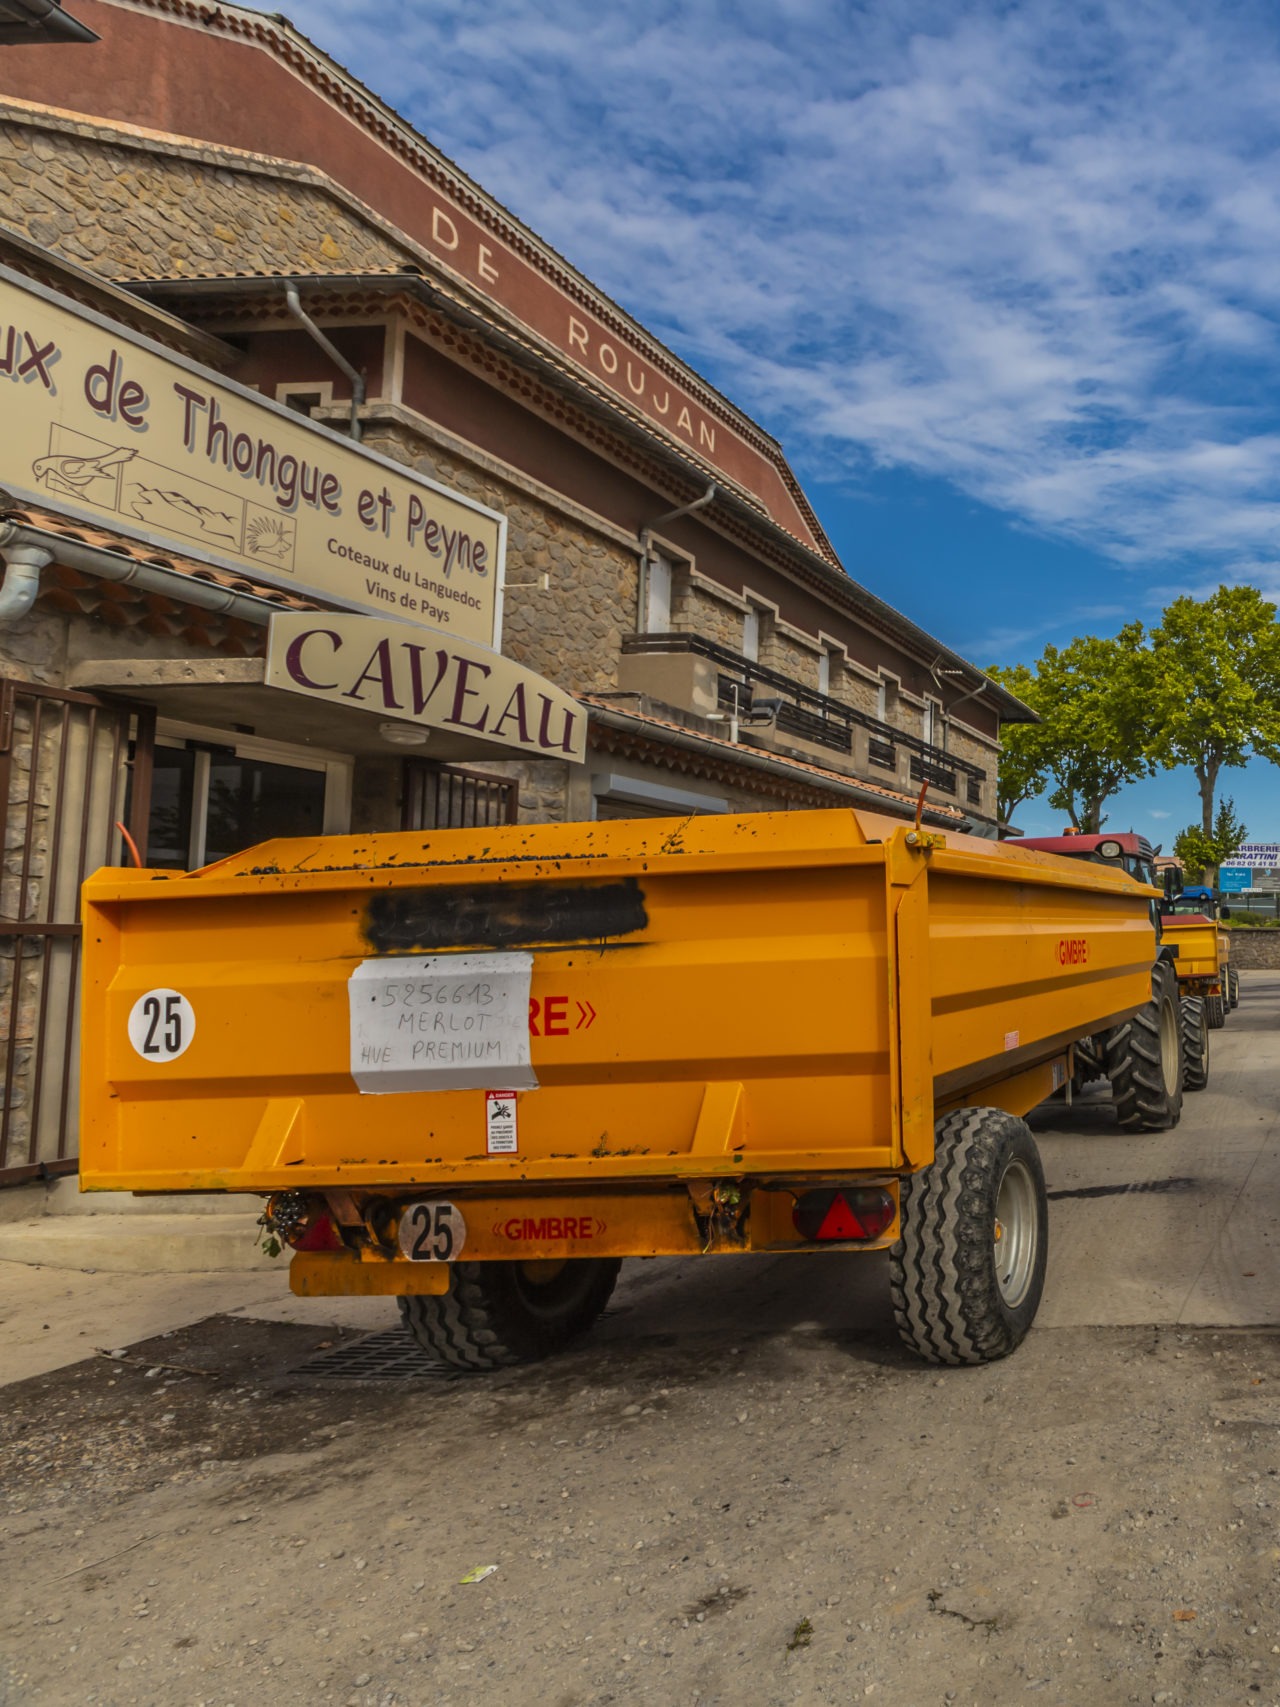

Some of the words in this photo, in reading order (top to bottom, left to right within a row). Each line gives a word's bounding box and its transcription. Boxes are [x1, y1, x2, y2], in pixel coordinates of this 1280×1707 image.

[432, 206, 499, 285] DE
[568, 315, 715, 453] ROUJAN
[84, 349, 145, 426] de
[173, 382, 340, 511] Thongue
[358, 486, 391, 534] et
[407, 494, 486, 574] Peyne
[327, 538, 389, 574] Coteaux
[393, 564, 410, 583] du
[415, 572, 481, 610] Languedoc
[366, 579, 396, 603] Vins
[400, 593, 417, 610] de
[421, 601, 450, 623] Pays
[285, 629, 578, 754] CAVEAU
[381, 983, 494, 1008] 5256613
[398, 1011, 492, 1034] MERLOT
[143, 996, 182, 1053] 25
[412, 1040, 502, 1061] PREMIUM
[411, 1205, 453, 1261] 25
